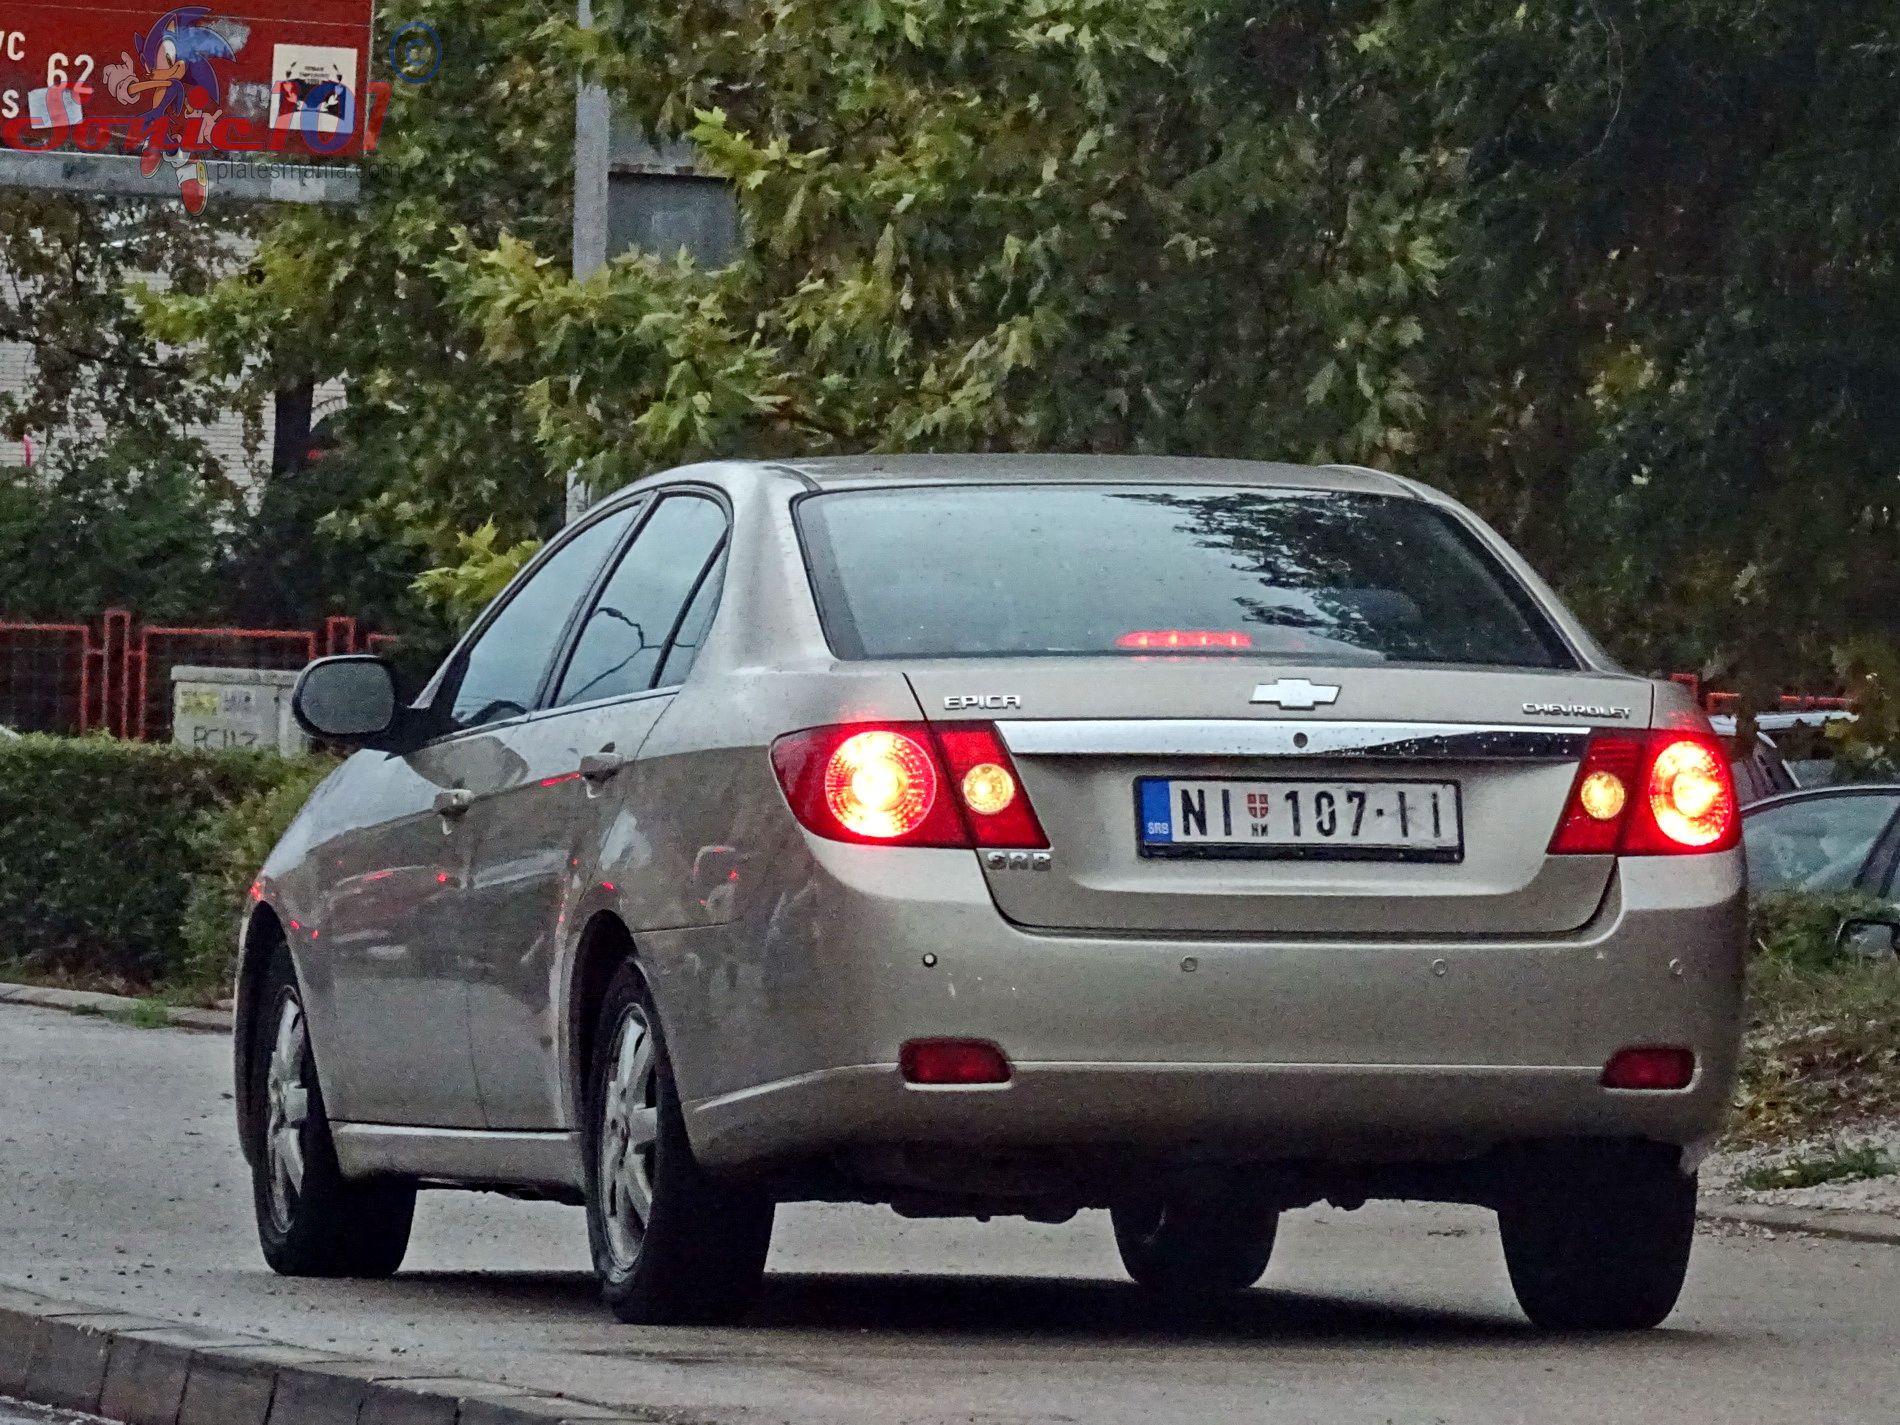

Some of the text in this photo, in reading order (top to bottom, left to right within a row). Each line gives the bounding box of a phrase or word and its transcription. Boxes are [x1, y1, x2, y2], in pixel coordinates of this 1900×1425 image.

[47, 52, 95, 94] 62
[944, 695, 1021, 710] EPICA
[1522, 702, 1631, 719] CHEVROLET
[1180, 788, 1232, 836] NI
[1147, 821, 1170, 835] SRB
